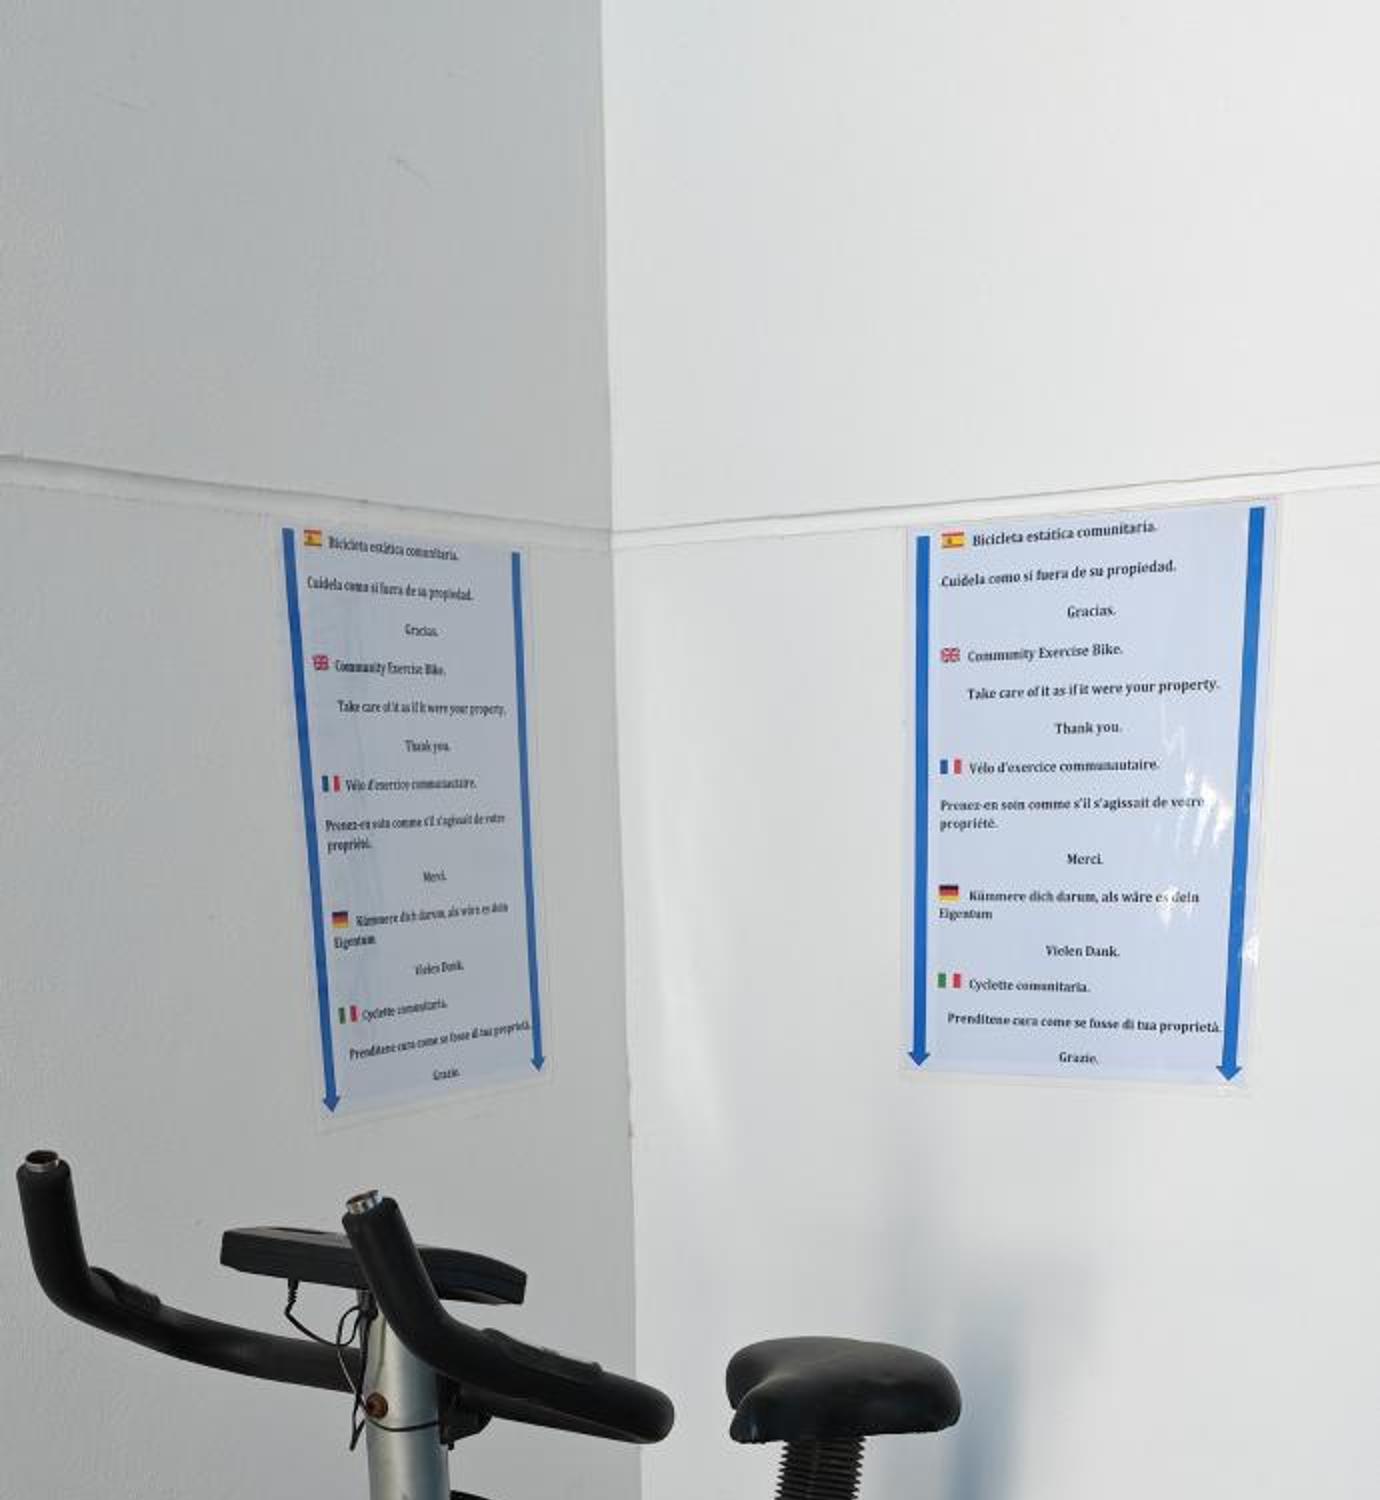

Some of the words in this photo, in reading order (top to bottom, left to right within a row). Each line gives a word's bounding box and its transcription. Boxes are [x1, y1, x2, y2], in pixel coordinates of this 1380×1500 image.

[972, 531, 1023, 547] Bicicleta
[1027, 527, 1074, 542] estática
[1077, 520, 1157, 539] comunitaria.
[988, 571, 1021, 585] como
[1023, 568, 1033, 581] si
[1036, 567, 1068, 581] fuera
[1071, 566, 1086, 579] de
[1089, 567, 1103, 578] su
[1107, 559, 1176, 578] propiedad.
[1067, 605, 1116, 619] Gracias.
[967, 648, 1034, 663] Community
[1038, 645, 1088, 660] Exercise
[1092, 643, 1123, 656] Bike.
[967, 687, 996, 700] Take
[999, 689, 1024, 699] care
[1027, 685, 1040, 699] of
[1041, 685, 1050, 698] it
[1053, 688, 1066, 698] as
[1069, 684, 1080, 696] if
[1080, 684, 1089, 696] it
[1092, 684, 1122, 695] were
[1125, 681, 1156, 695] your
[1159, 678, 1220, 692] property.
[1054, 722, 1092, 735] Thank
[969, 761, 998, 775] Vélo
[940, 799, 998, 812] Prenez-en
[1002, 799, 1025, 811] soin
[1028, 800, 1071, 810] comme
[1152, 796, 1168, 808] de
[969, 889, 1027, 902] Kümmere
[1029, 890, 1052, 903] dich
[1102, 891, 1119, 903] als
[938, 908, 992, 921] Eigentum
[1045, 944, 1083, 958] Vielen
[1085, 944, 1120, 957] Dank.
[969, 978, 1013, 994] Cyclette
[1016, 980, 1090, 993] comunitaria.
[948, 1012, 1010, 1026] Prenditene
[1040, 1017, 1070, 1028] come
[1075, 1019, 1087, 1029] se
[1089, 1017, 1119, 1030] fosse
[1122, 1019, 1135, 1030] di
[1138, 1021, 1157, 1032] tua
